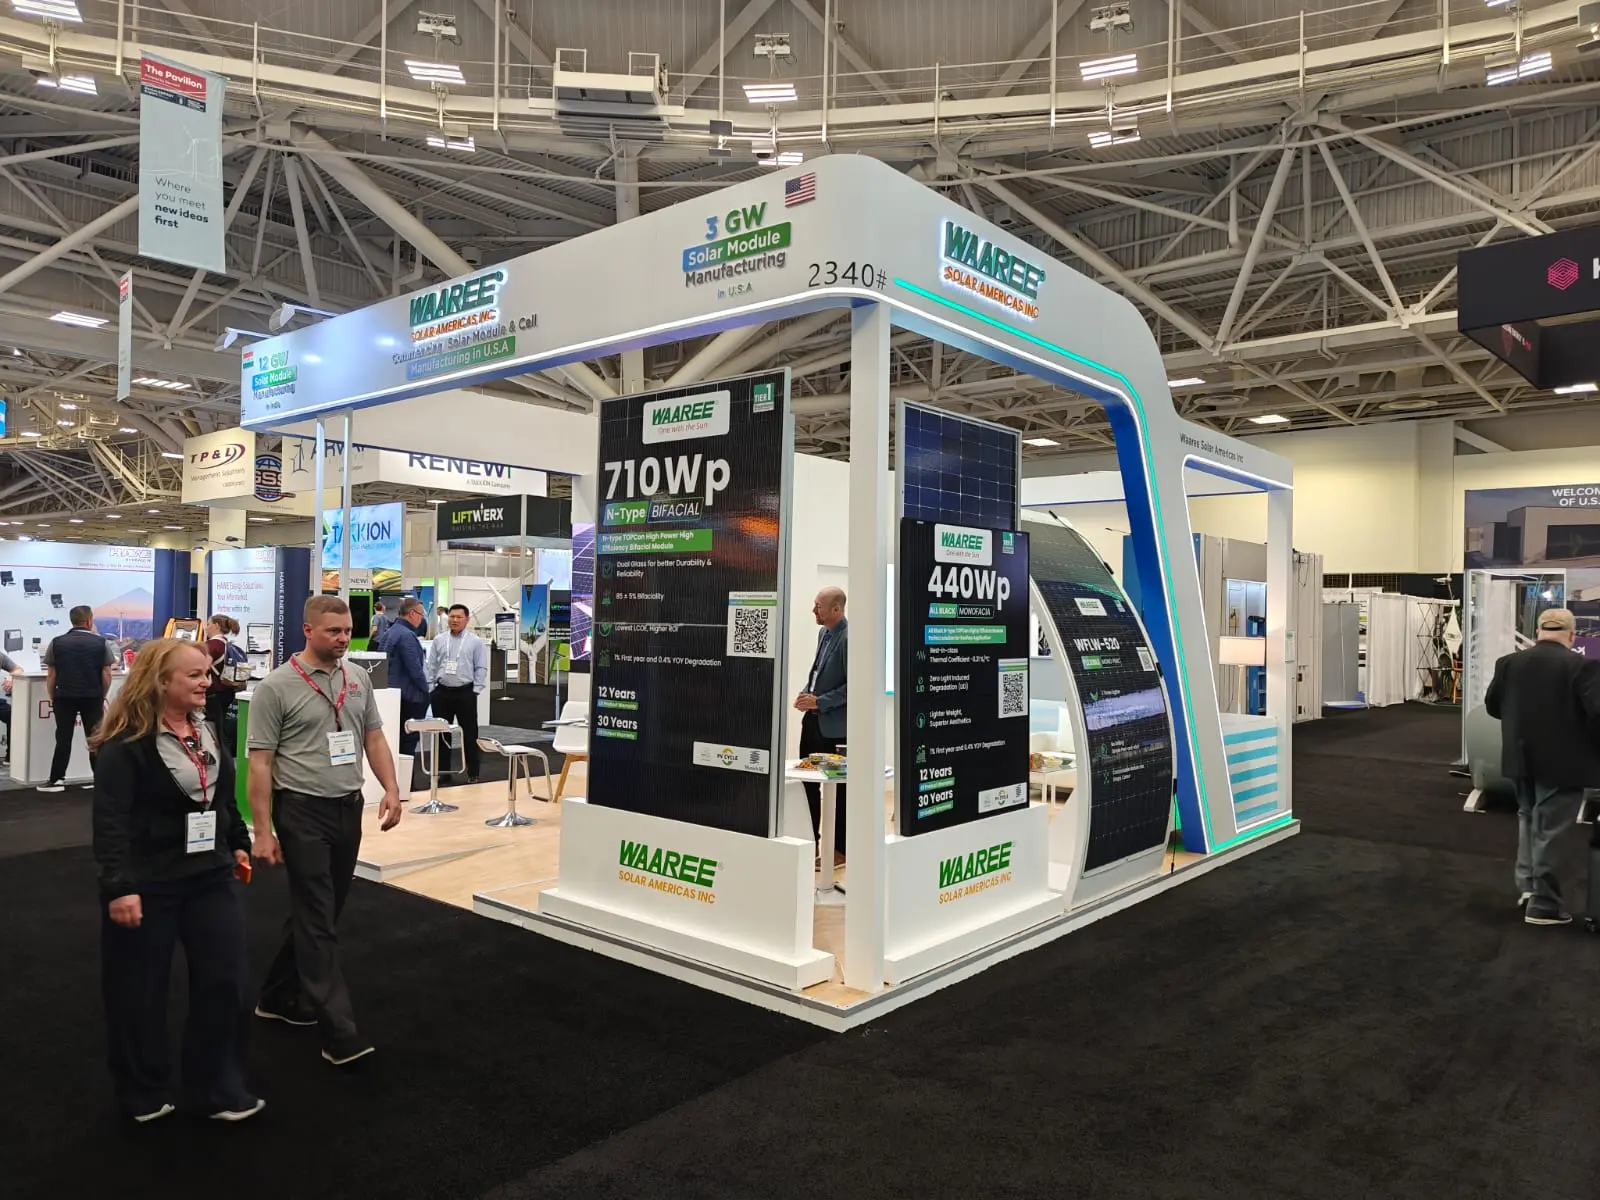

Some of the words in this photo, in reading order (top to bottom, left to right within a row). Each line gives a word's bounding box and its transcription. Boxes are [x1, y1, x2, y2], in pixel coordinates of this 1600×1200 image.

[145, 64, 164, 77] The
[165, 70, 203, 89] Pavilion
[155, 176, 191, 193] Where
[155, 191, 176, 202] you
[179, 197, 206, 210] meet
[155, 204, 178, 215] new
[179, 208, 209, 223] ideas
[155, 215, 179, 228] first
[705, 215, 718, 240] 3
[724, 201, 768, 234] GW
[688, 246, 723, 266] Solar
[726, 230, 781, 256] Module
[685, 250, 786, 288] Manufacturing
[943, 221, 1040, 300] WAAREE
[410, 271, 497, 328] WAAREE
[944, 266, 977, 291] SOLAR
[977, 281, 1024, 312] AMERICAS
[1024, 305, 1040, 319] INC
[478, 308, 497, 323] INC
[447, 335, 470, 350] Solar
[472, 325, 506, 341] Module
[508, 320, 516, 333] &
[518, 313, 537, 331] Cell
[259, 356, 269, 371] 12
[271, 350, 289, 368] GW
[410, 353, 470, 374] Manufacturing
[472, 347, 481, 358] in
[483, 341, 509, 357] U.S.A
[254, 375, 269, 387] Solar
[269, 369, 293, 383] Module
[652, 400, 715, 426] WAAREE
[685, 423, 695, 431] the
[696, 422, 708, 430] Sun
[1179, 431, 1200, 449] Waaree
[1201, 439, 1214, 453] Solar
[604, 453, 731, 506] 710Wp
[606, 507, 647, 522] N-Type
[651, 502, 700, 518] BIFACIAL
[1559, 498, 1576, 506] OF
[646, 532, 659, 541] High
[680, 530, 694, 540] High
[941, 531, 983, 551] WAAREE
[630, 560, 646, 568] Glass
[657, 558, 675, 567] better
[676, 558, 705, 567] Durability
[637, 592, 664, 602] Bifaciality
[927, 565, 1011, 611] 440Wp
[658, 656, 671, 664] 0.4%
[685, 658, 722, 667] Degradation
[598, 686, 607, 697] 12
[608, 687, 636, 700] Years
[929, 684, 958, 693] Degradation
[597, 715, 609, 727] 30
[610, 716, 638, 730] Years
[929, 711, 945, 719] Lighter
[929, 719, 949, 728] Superior
[920, 769, 928, 781] 12
[929, 766, 952, 779] Years
[918, 795, 929, 807] 30
[930, 790, 954, 804] Years
[620, 839, 718, 888] WAAREE
[939, 841, 1012, 889] WAAREE
[618, 870, 647, 886] SOLAR
[648, 878, 696, 899] AMERICAS
[697, 891, 716, 904] INC
[939, 888, 962, 904] SOLAR
[963, 875, 999, 896] AMERICAS
[1000, 871, 1012, 883] INC
